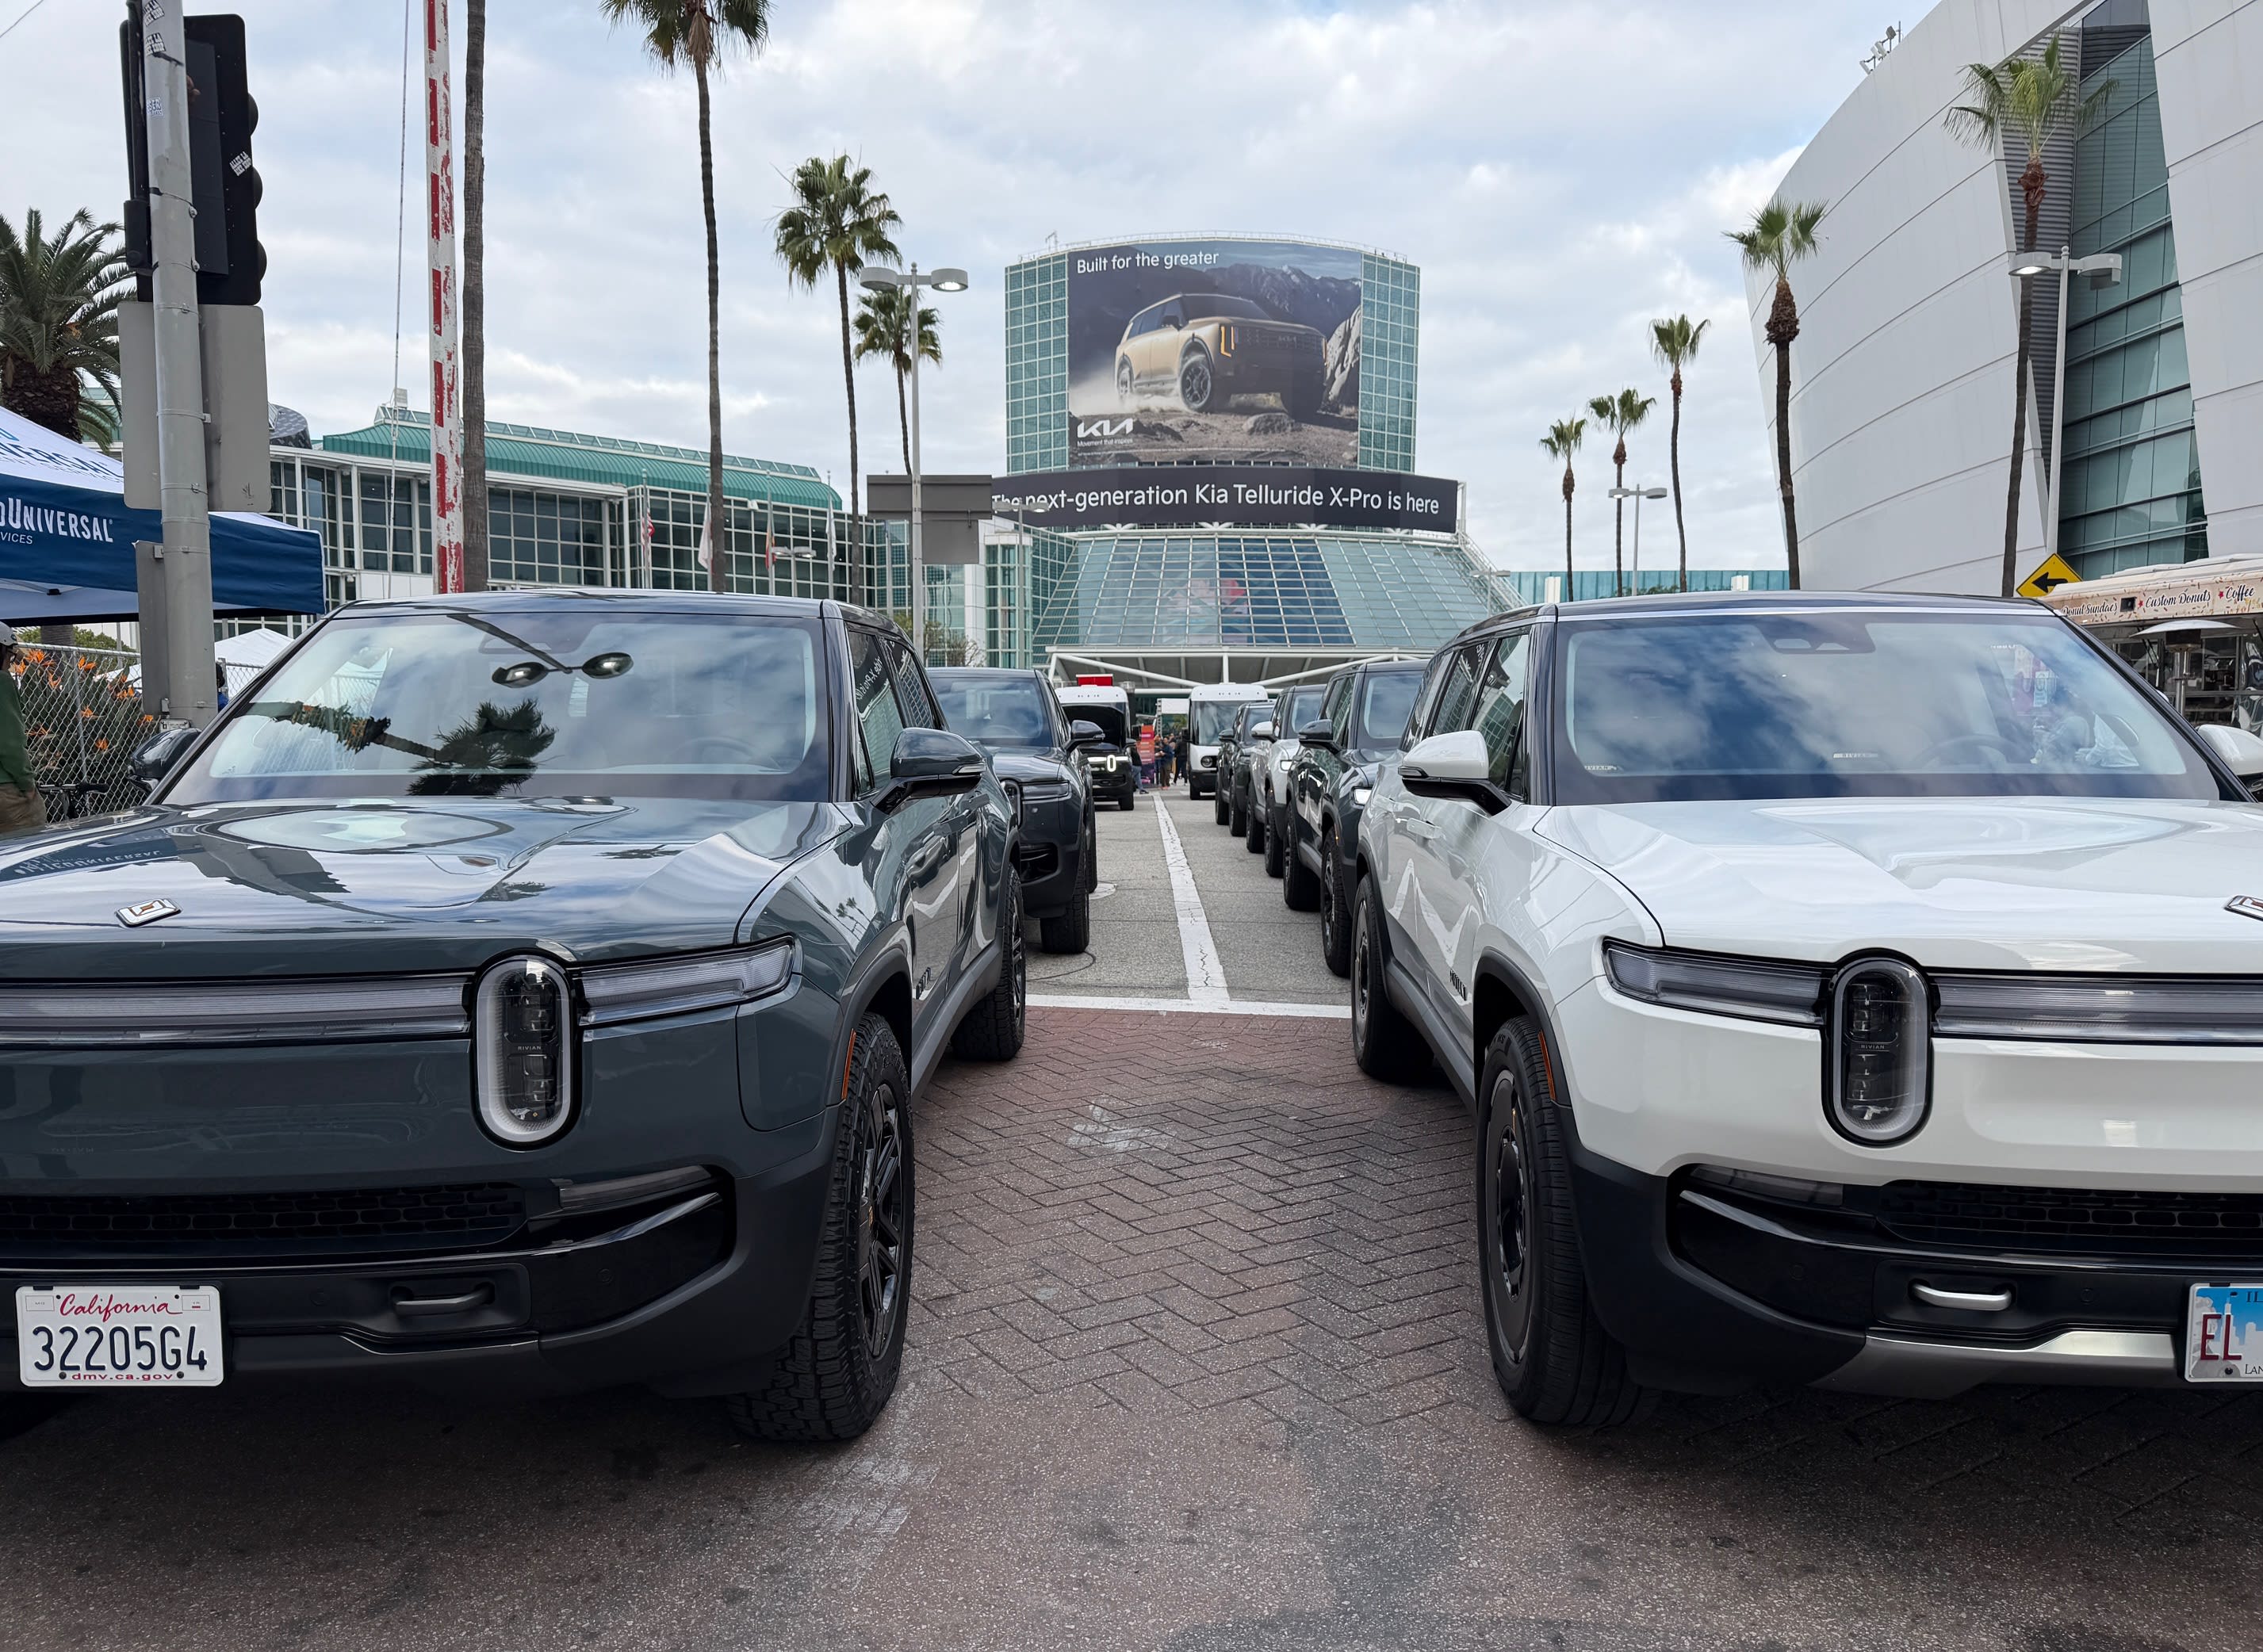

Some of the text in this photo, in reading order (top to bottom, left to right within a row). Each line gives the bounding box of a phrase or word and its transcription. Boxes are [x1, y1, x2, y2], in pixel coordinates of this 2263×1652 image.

[1077, 250, 1219, 274] Built for the greater
[1078, 418, 1133, 438] KIA
[1025, 484, 1188, 512] next-generation
[1196, 484, 1228, 504] Kia
[1233, 484, 1324, 507] Telluride
[1329, 486, 1382, 510] X-Pro
[1388, 490, 1402, 511] is
[1406, 491, 1440, 514] here
[2145, 595, 2177, 608] Custom
[2178, 589, 2211, 604] Donuts
[2226, 584, 2254, 602] Coffee
[59, 1294, 183, 1322] California
[33, 1325, 208, 1371] 32205G4
[2200, 1314, 2242, 1360] EL
[71, 1372, 173, 1382] dmv.ca.gov
